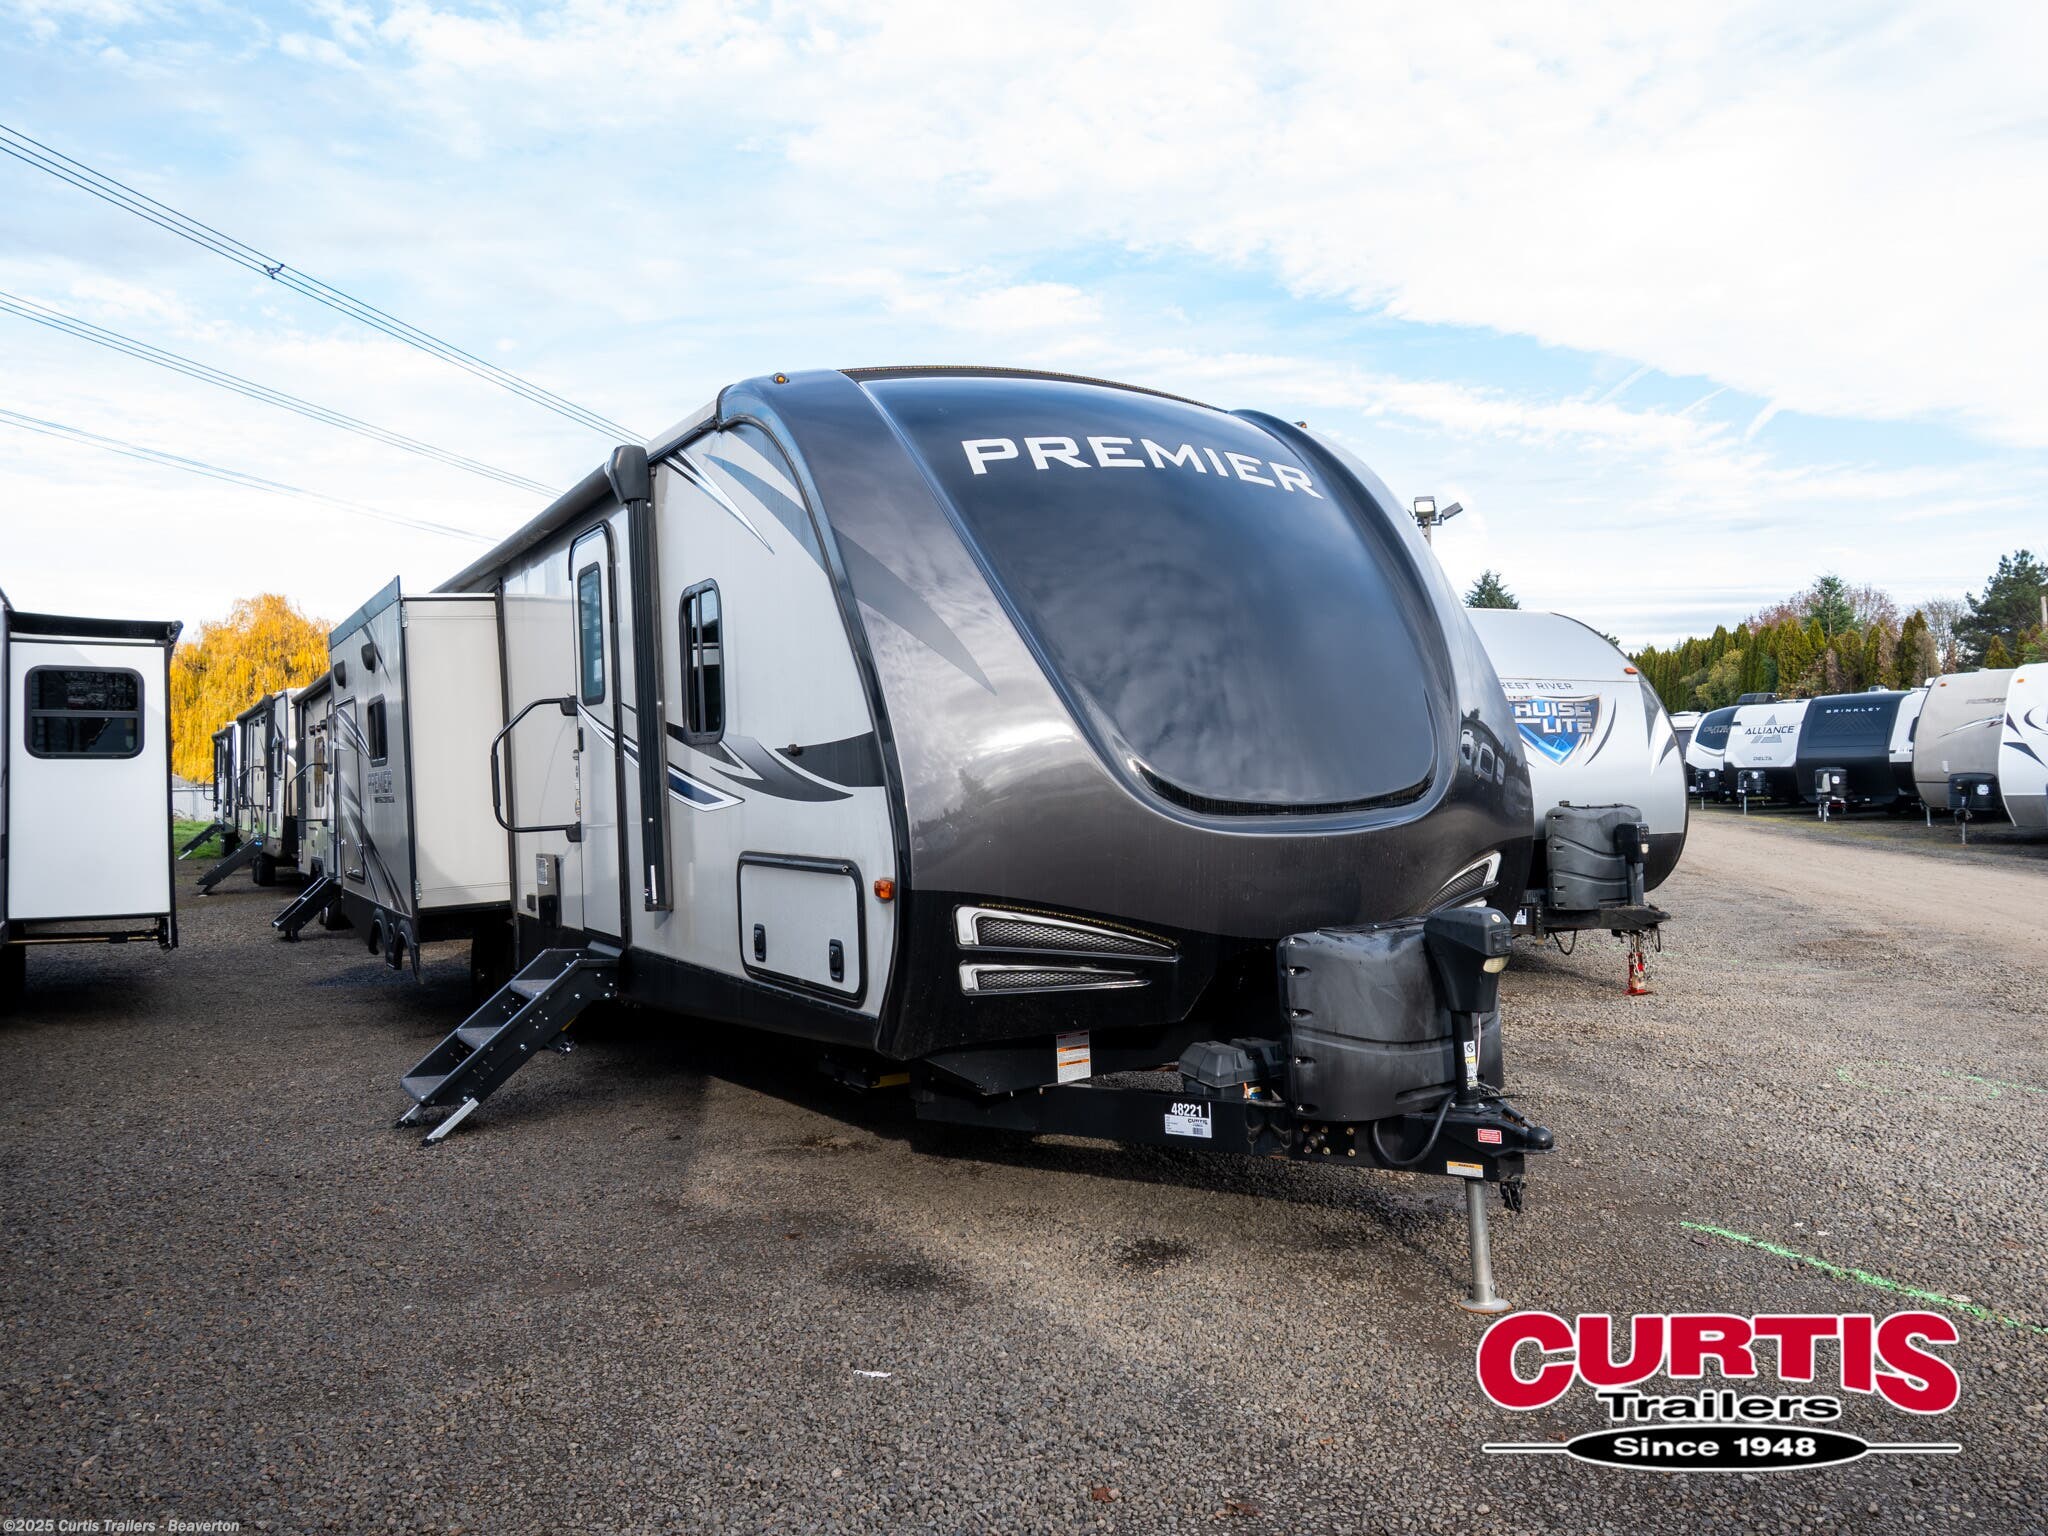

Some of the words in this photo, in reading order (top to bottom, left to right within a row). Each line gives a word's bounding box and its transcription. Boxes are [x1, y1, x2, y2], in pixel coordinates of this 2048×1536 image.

[961, 436, 1324, 499] PREMIER
[1500, 682, 1530, 690] REST
[1536, 682, 1574, 690] RIVER
[1510, 701, 1591, 717] RUISE
[1542, 717, 1594, 733] LITE
[1744, 725, 1795, 735] ALLIANCE
[1171, 1102, 1202, 1117] 48221
